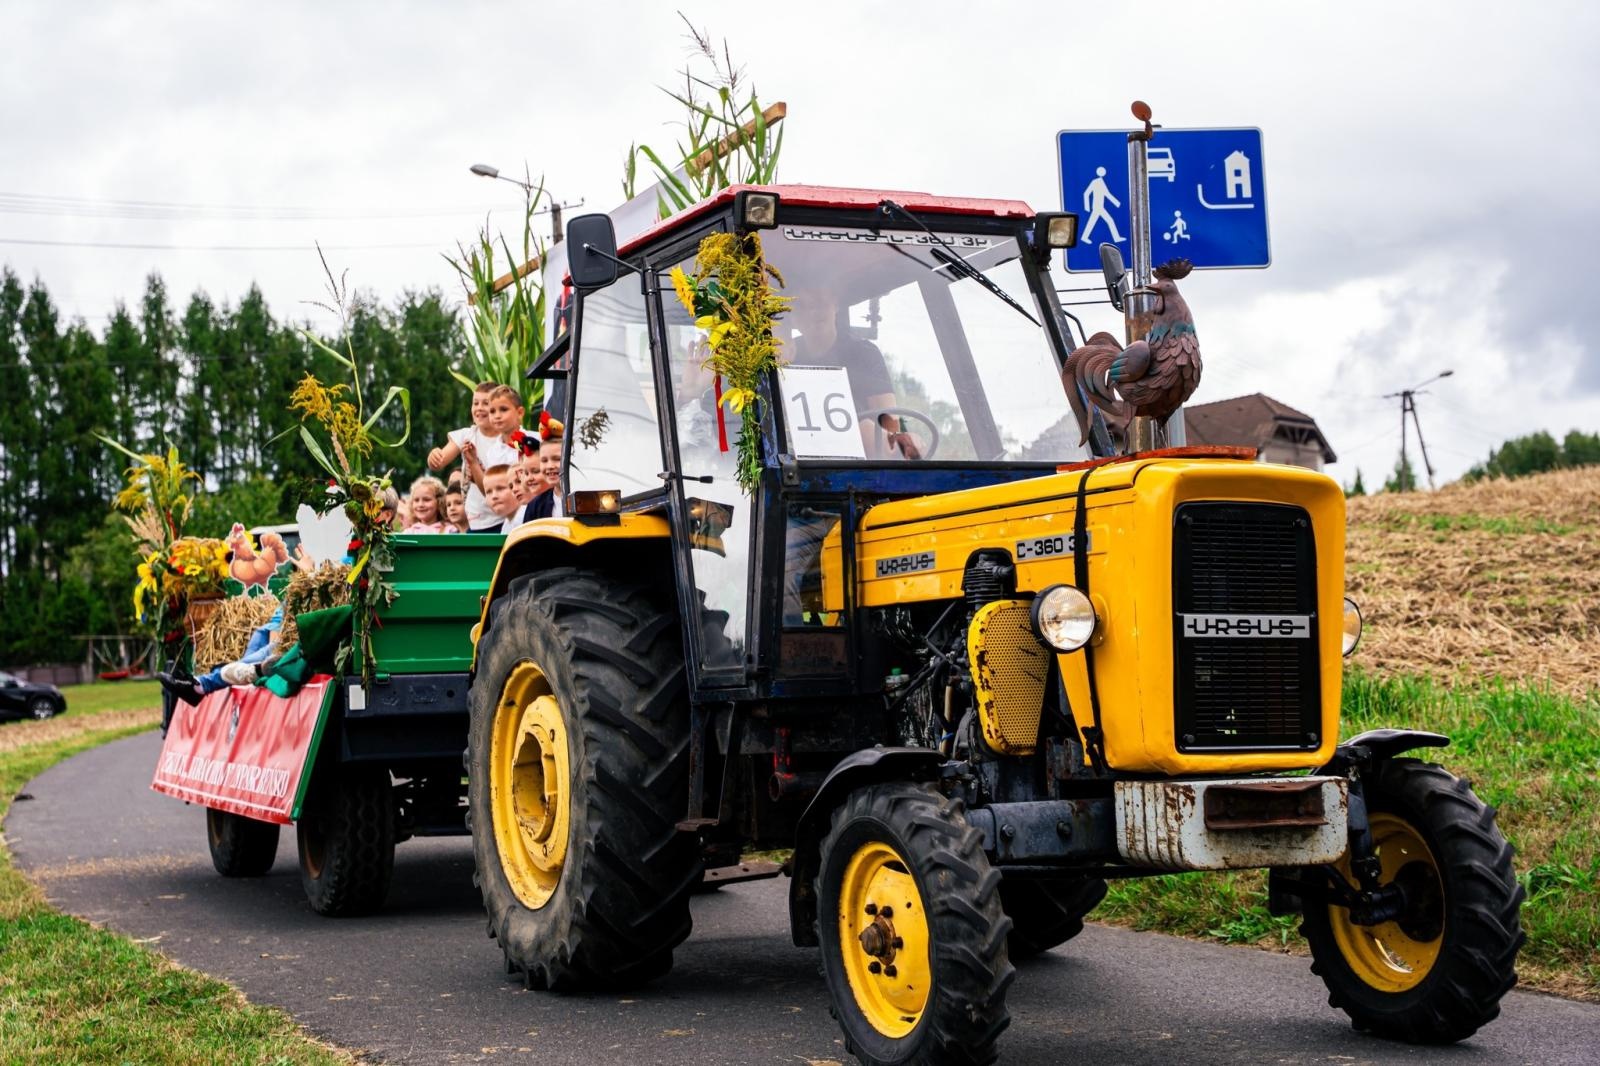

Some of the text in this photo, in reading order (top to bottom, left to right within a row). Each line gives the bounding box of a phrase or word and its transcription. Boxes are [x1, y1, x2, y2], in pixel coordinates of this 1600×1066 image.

[791, 391, 853, 432] 16
[1016, 537, 1064, 558] C-360
[878, 553, 935, 575] URSUS
[1186, 618, 1306, 635] URSUS
